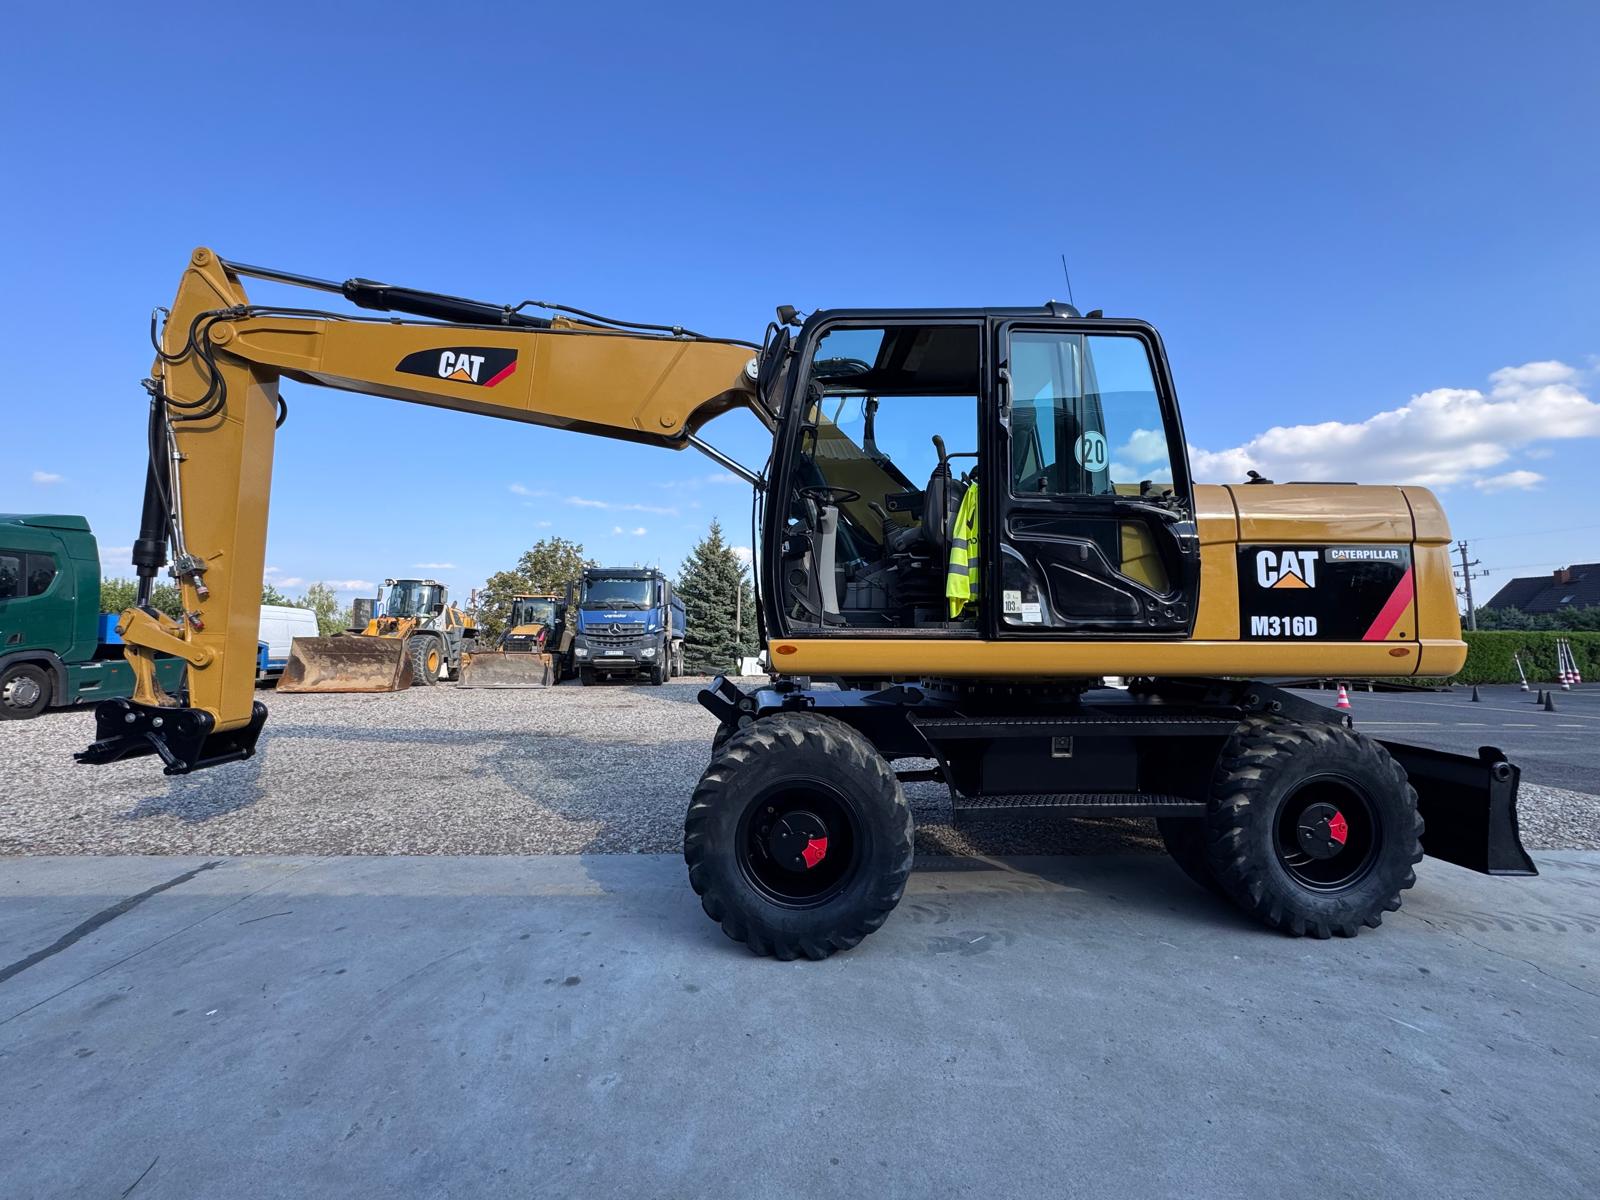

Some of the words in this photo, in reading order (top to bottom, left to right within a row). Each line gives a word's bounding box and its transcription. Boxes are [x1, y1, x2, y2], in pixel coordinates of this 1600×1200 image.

[438, 350, 485, 382] CAT
[1083, 438, 1104, 464] 20
[1331, 550, 1399, 560] CATERPILLAR
[1256, 550, 1319, 588] CAT
[1004, 600, 1016, 611] 103
[1251, 616, 1318, 636] M316D
